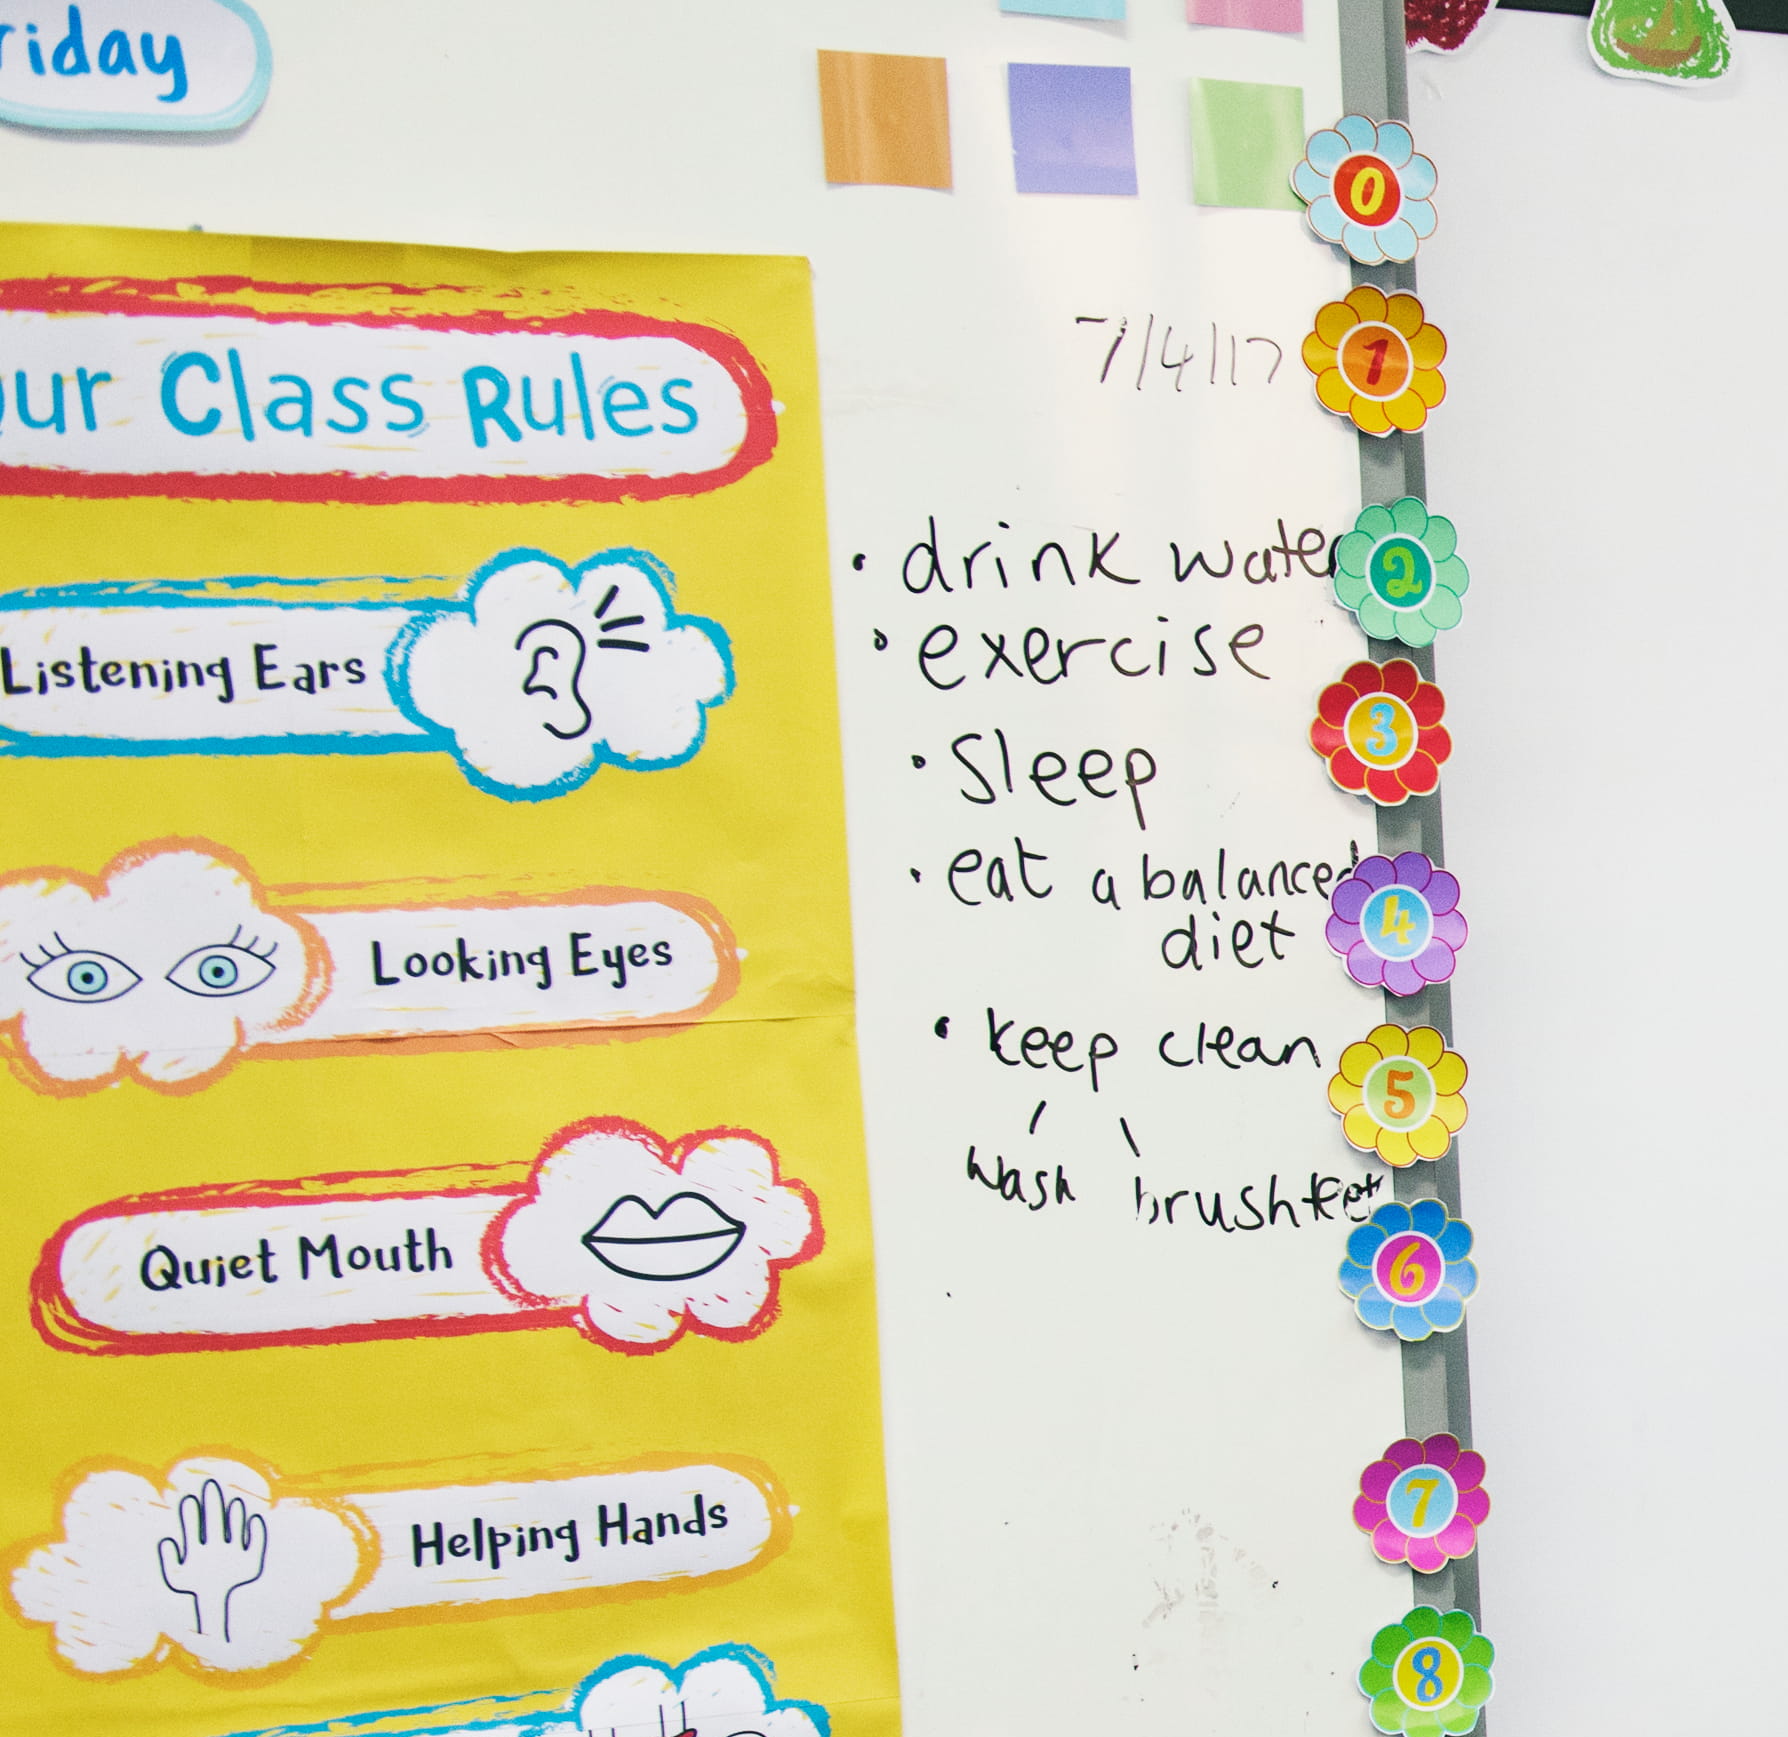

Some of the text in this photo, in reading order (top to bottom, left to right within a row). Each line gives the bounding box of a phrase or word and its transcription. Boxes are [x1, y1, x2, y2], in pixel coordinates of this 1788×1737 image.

[1350, 166, 1385, 217] 0
[1362, 337, 1389, 386] 1
[0, 347, 700, 448] ur Class Rules
[903, 515, 1141, 593] drink
[1381, 548, 1422, 599] 2
[0, 643, 366, 703] Listening Ears
[917, 615, 1271, 691] exercise
[1366, 702, 1397, 757] 3
[946, 836, 1053, 906] eat
[1091, 867, 1121, 911] a
[1161, 909, 1296, 971] diet
[1379, 895, 1413, 946] 4
[370, 930, 674, 990] Looking Eyes
[987, 1006, 1321, 1092] keep clean
[1383, 1069, 1418, 1120] 5
[139, 1227, 453, 1292] Quiet Mouth
[1389, 1240, 1427, 1297] 6
[1405, 1477, 1441, 1527] 7
[410, 1494, 729, 1571] Helping Hands
[1412, 1646, 1444, 1703] 8
